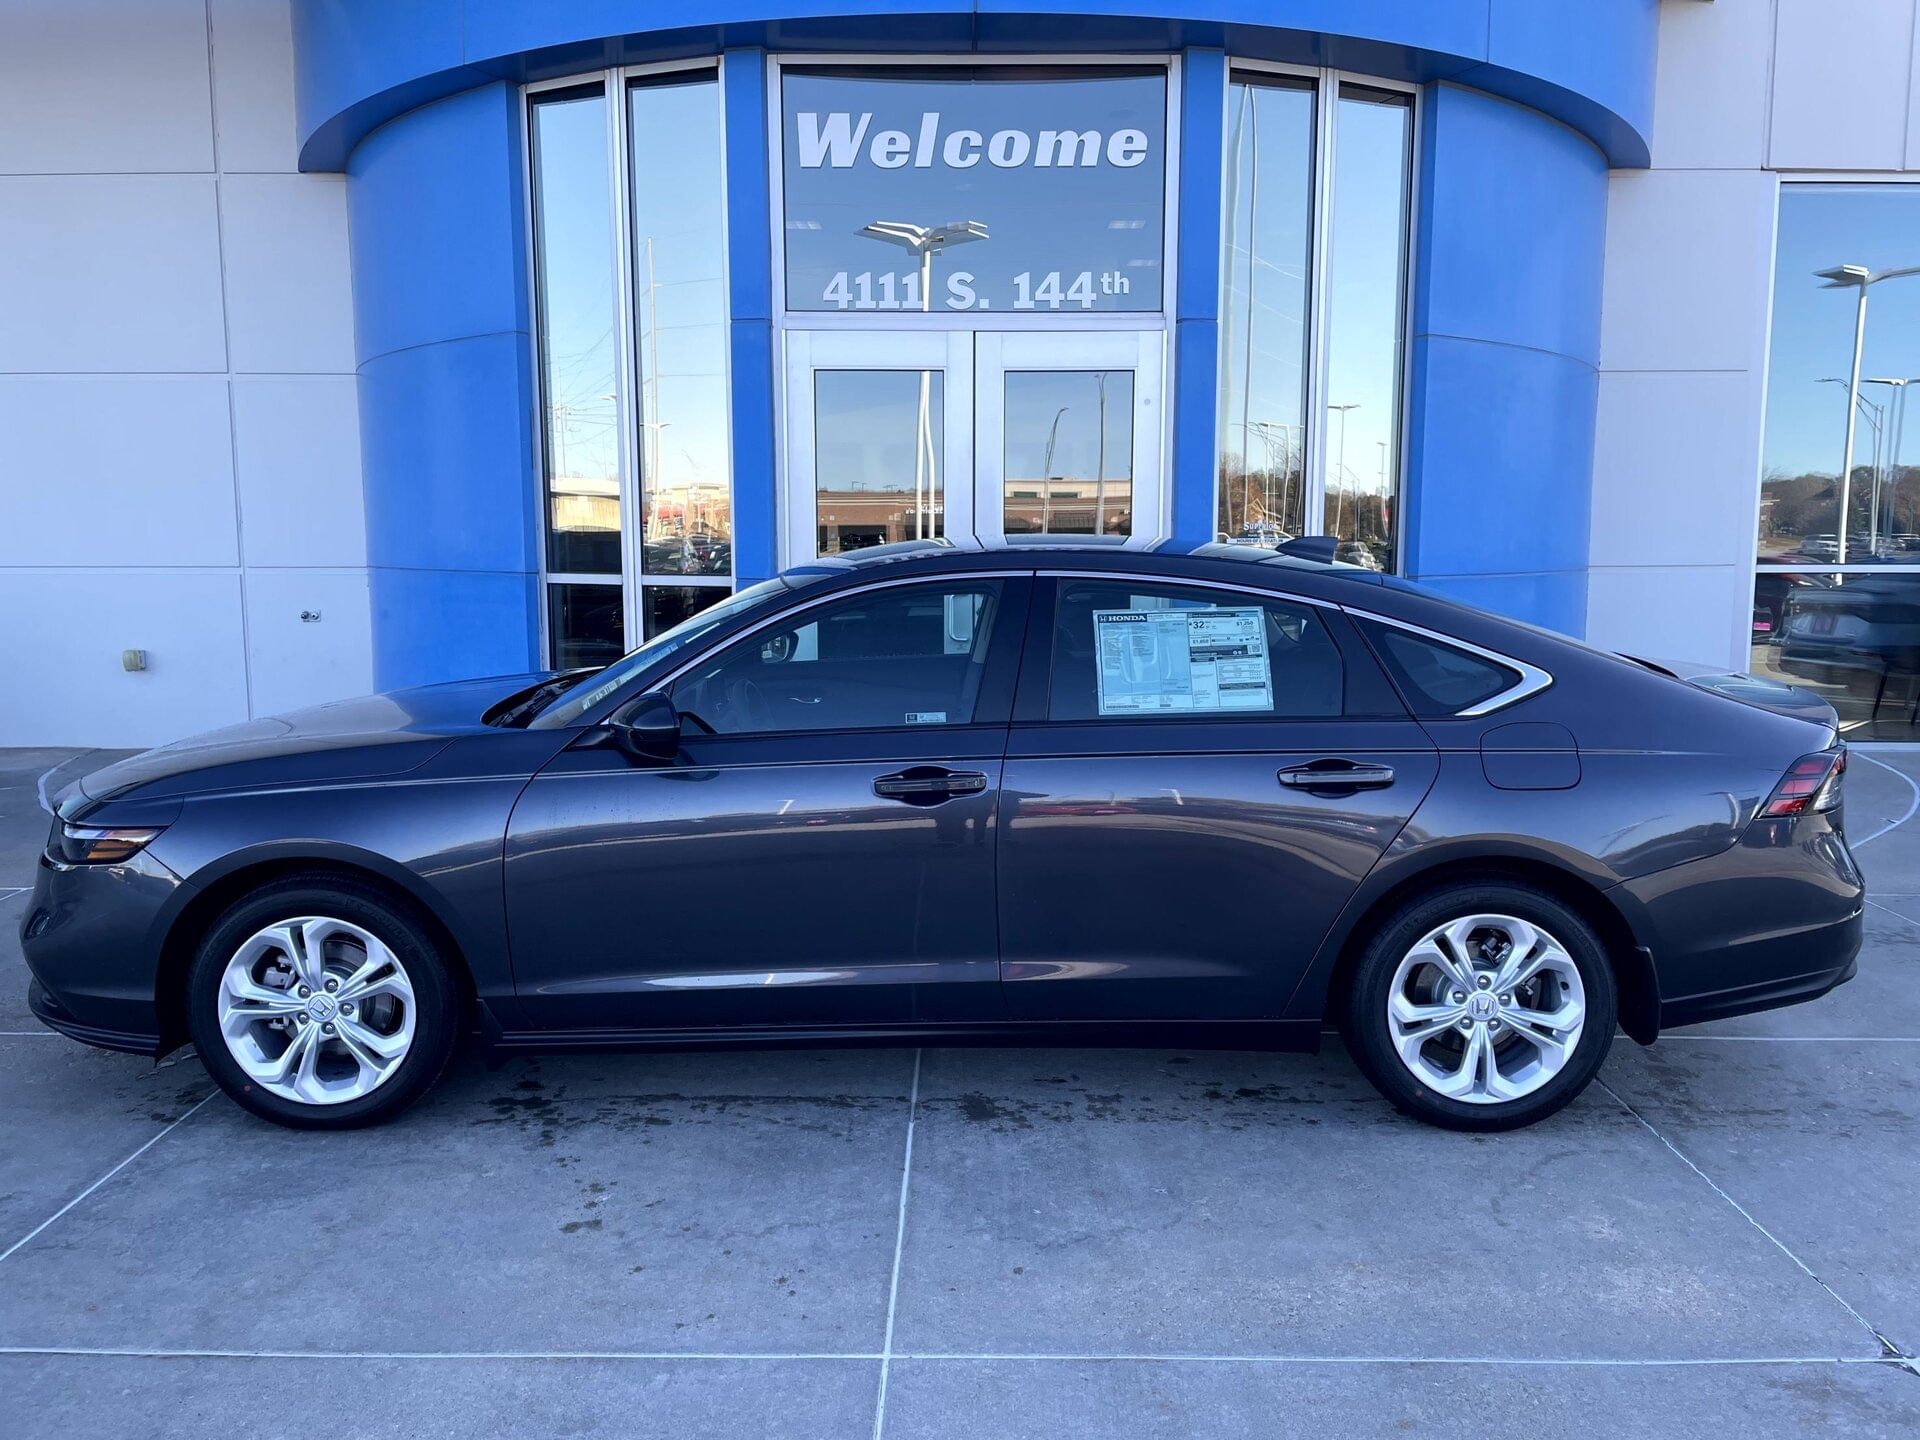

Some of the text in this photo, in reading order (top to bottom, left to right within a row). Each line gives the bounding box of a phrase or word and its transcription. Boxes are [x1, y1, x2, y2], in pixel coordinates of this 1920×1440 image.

[797, 112, 1148, 168] Welcome
[823, 271, 1130, 309] 4111 S. 144th
[1193, 621, 1205, 629] 32
